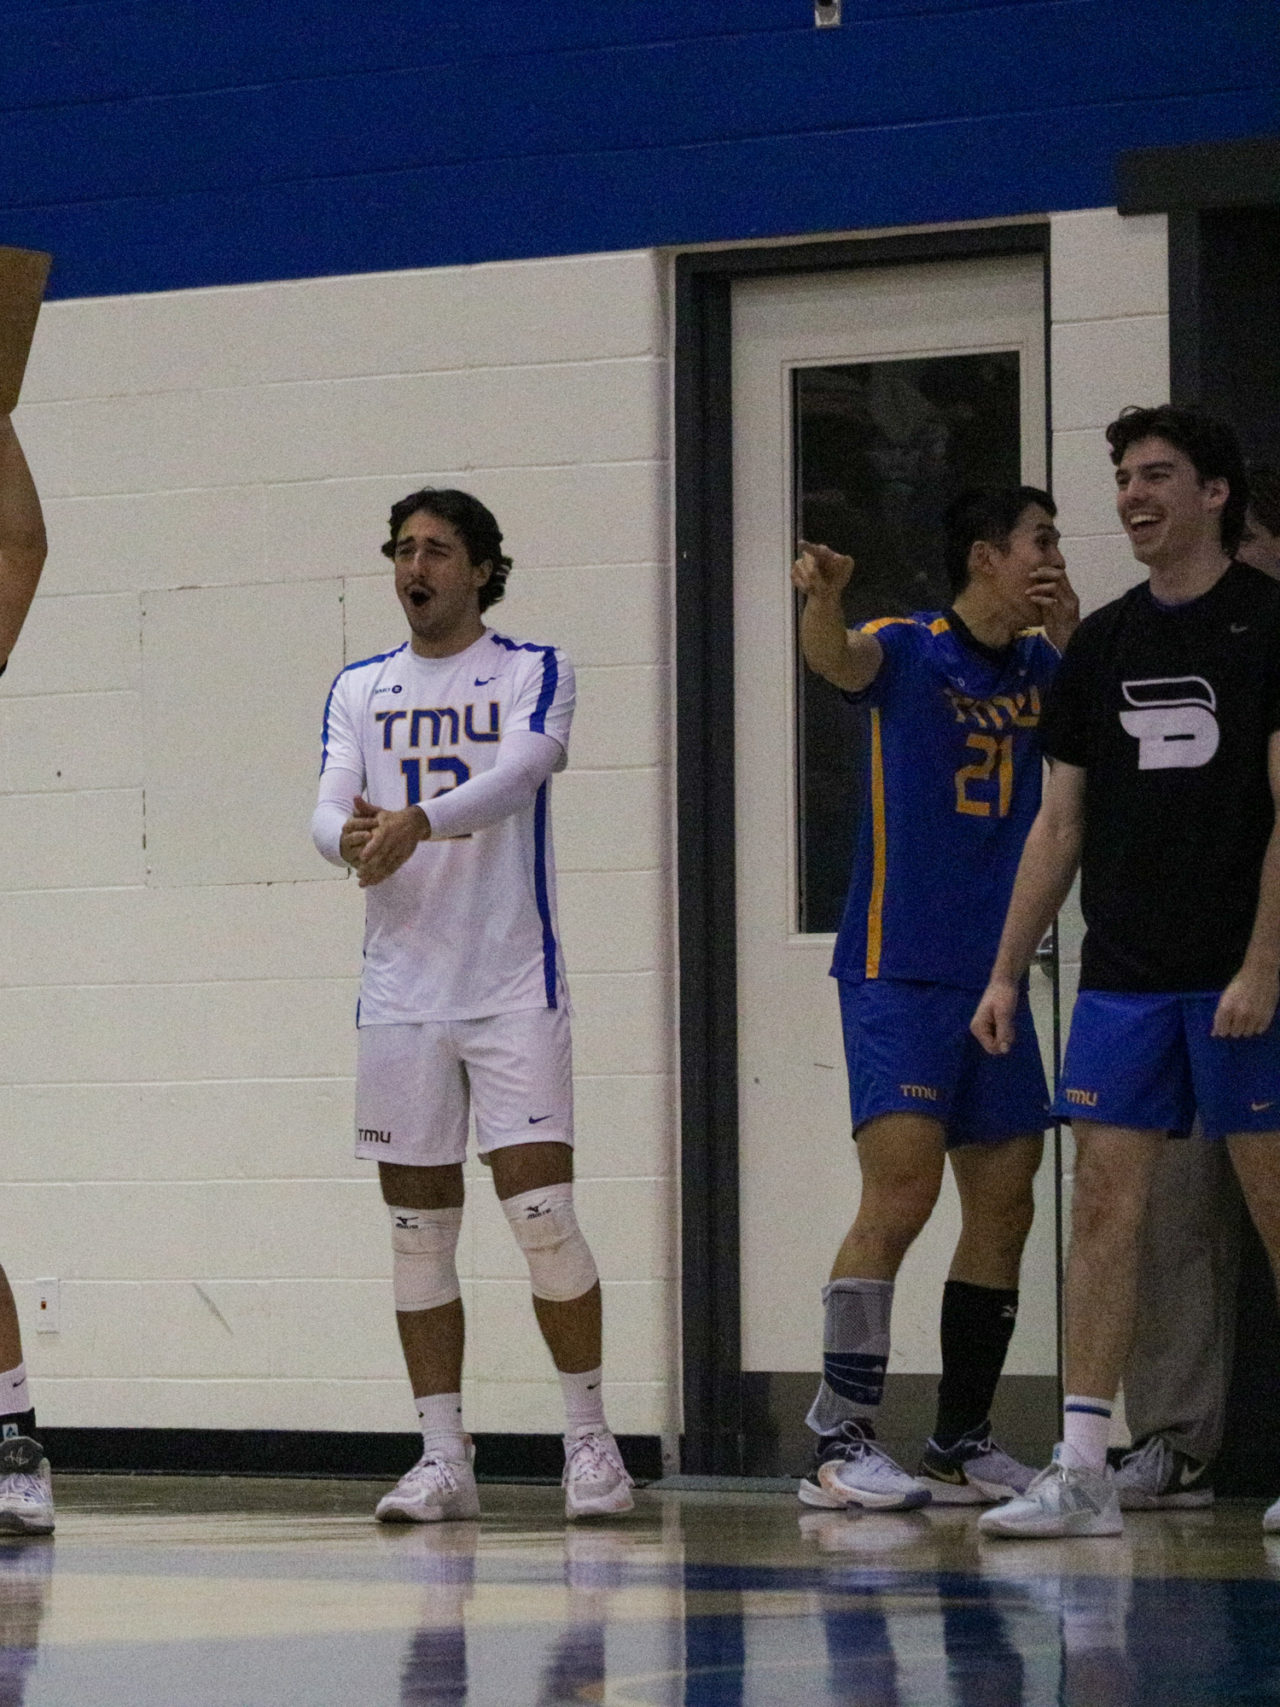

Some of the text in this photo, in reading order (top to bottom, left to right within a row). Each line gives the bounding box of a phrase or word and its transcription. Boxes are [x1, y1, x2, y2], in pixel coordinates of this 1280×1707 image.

[375, 702, 500, 750] TMU
[954, 732, 1013, 817] 21
[900, 1085, 937, 1101] TMU
[1065, 1088, 1097, 1107] TMU
[358, 1128, 392, 1144] TMU
